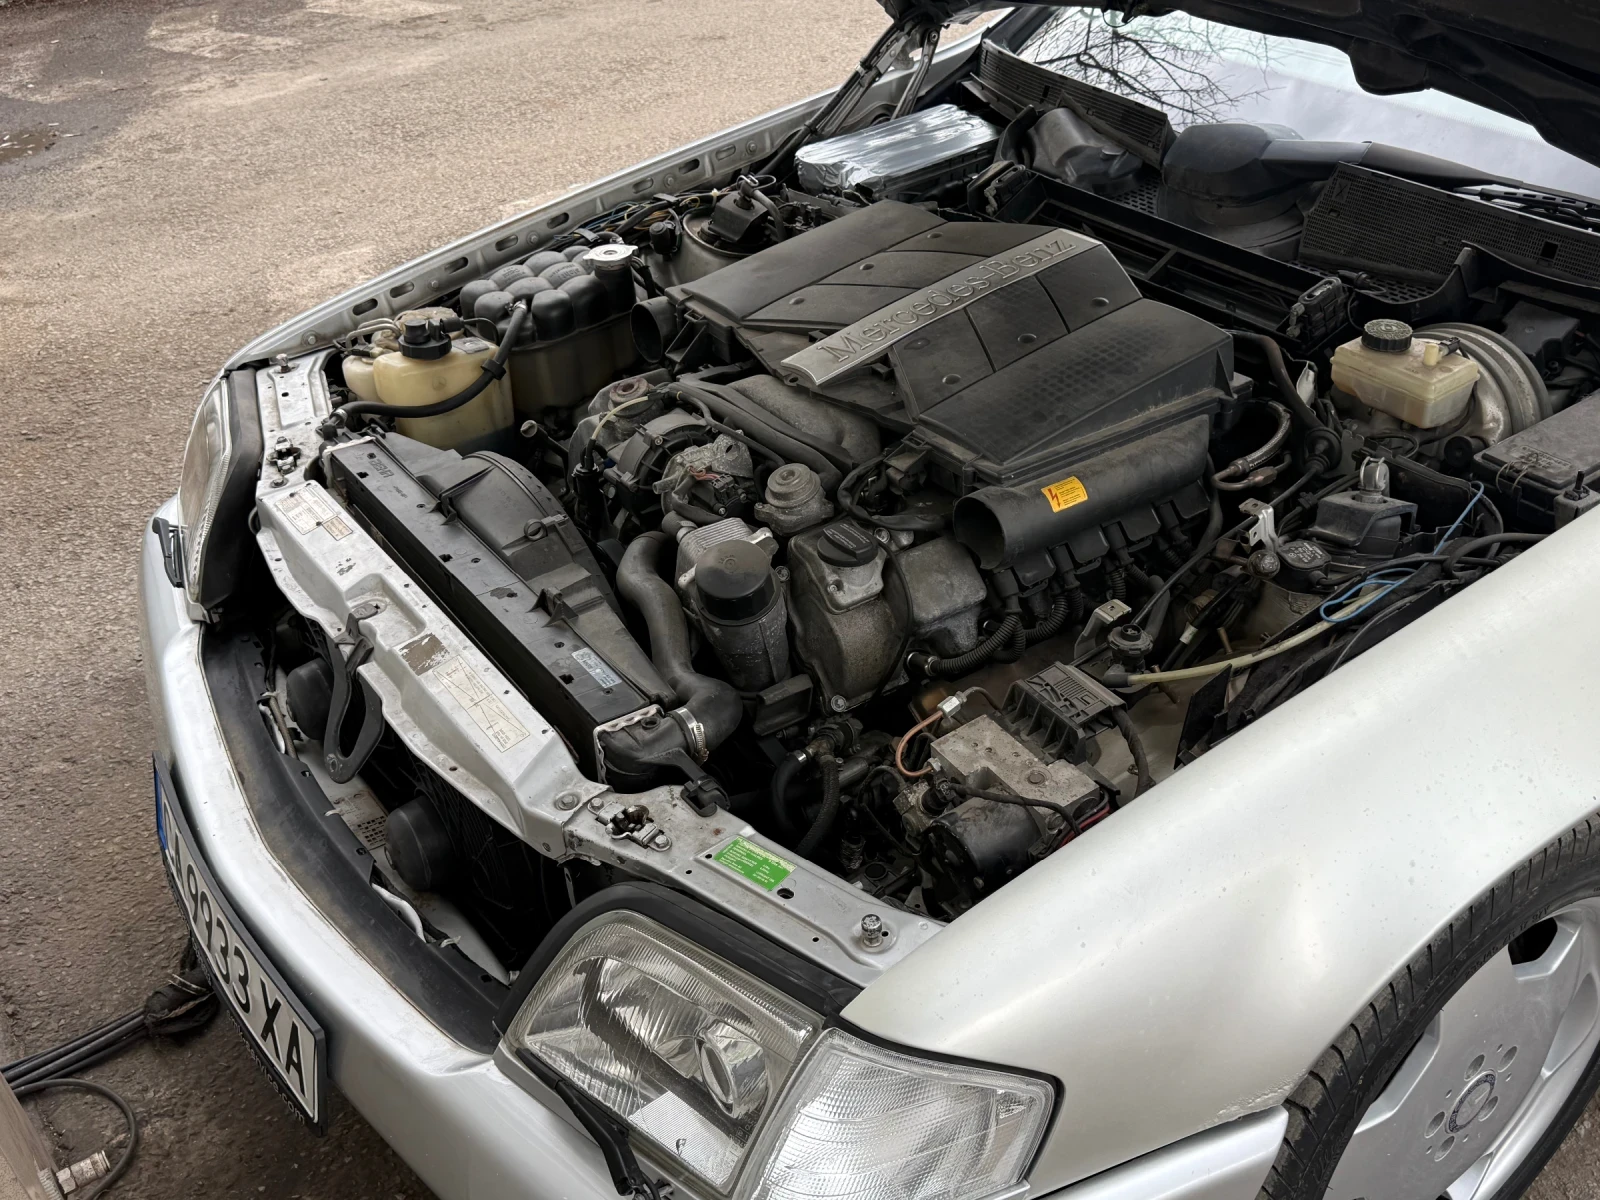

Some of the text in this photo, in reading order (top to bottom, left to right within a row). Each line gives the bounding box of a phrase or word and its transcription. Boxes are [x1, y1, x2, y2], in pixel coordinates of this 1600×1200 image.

[816, 238, 1077, 363] Mercedes-Benz
[187, 863, 252, 1014] 9933
[260, 976, 307, 1099] XA
